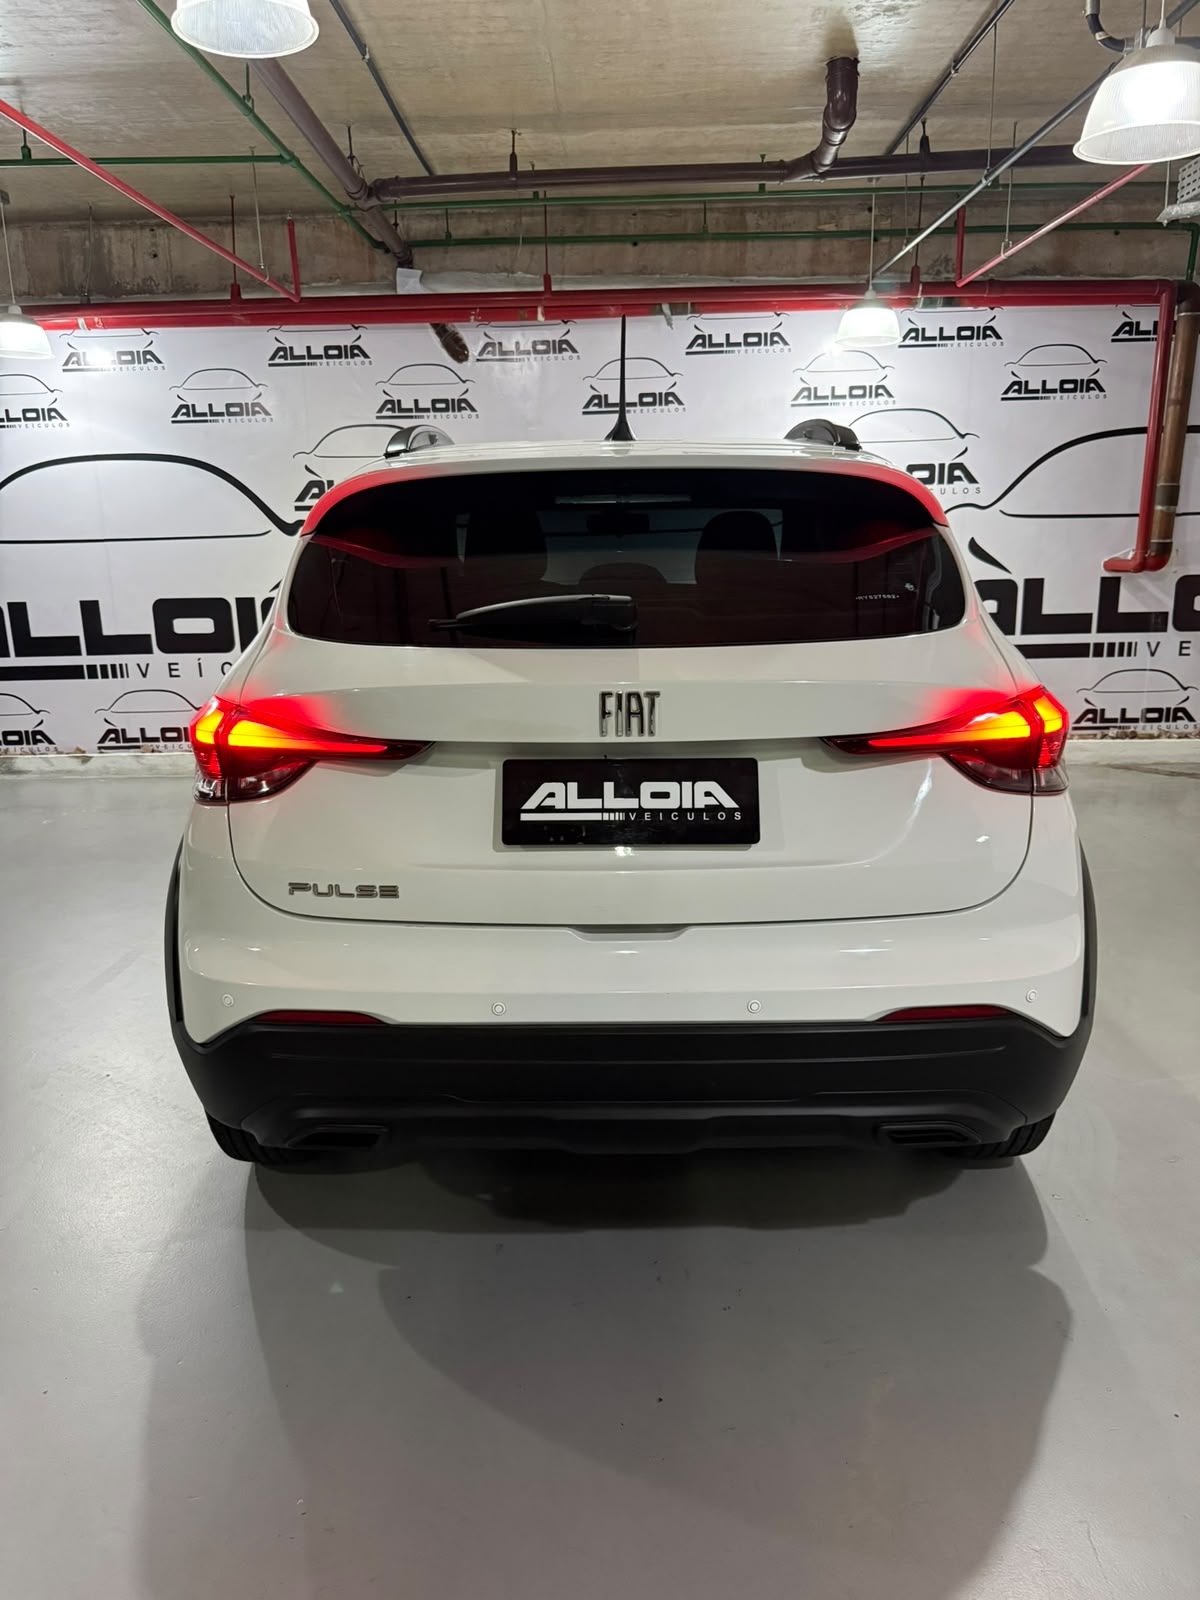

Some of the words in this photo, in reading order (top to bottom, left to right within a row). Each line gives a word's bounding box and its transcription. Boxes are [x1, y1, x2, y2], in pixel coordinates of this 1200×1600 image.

[62, 350, 164, 367] ALOIA
[0, 407, 68, 423] LOIA
[0, 596, 276, 658] LLOI
[599, 690, 661, 738] FIAT
[0, 729, 56, 746] OIA
[520, 780, 741, 810] ALLOIA
[628, 811, 742, 821] VEICULOS
[287, 882, 400, 899] PULSE
